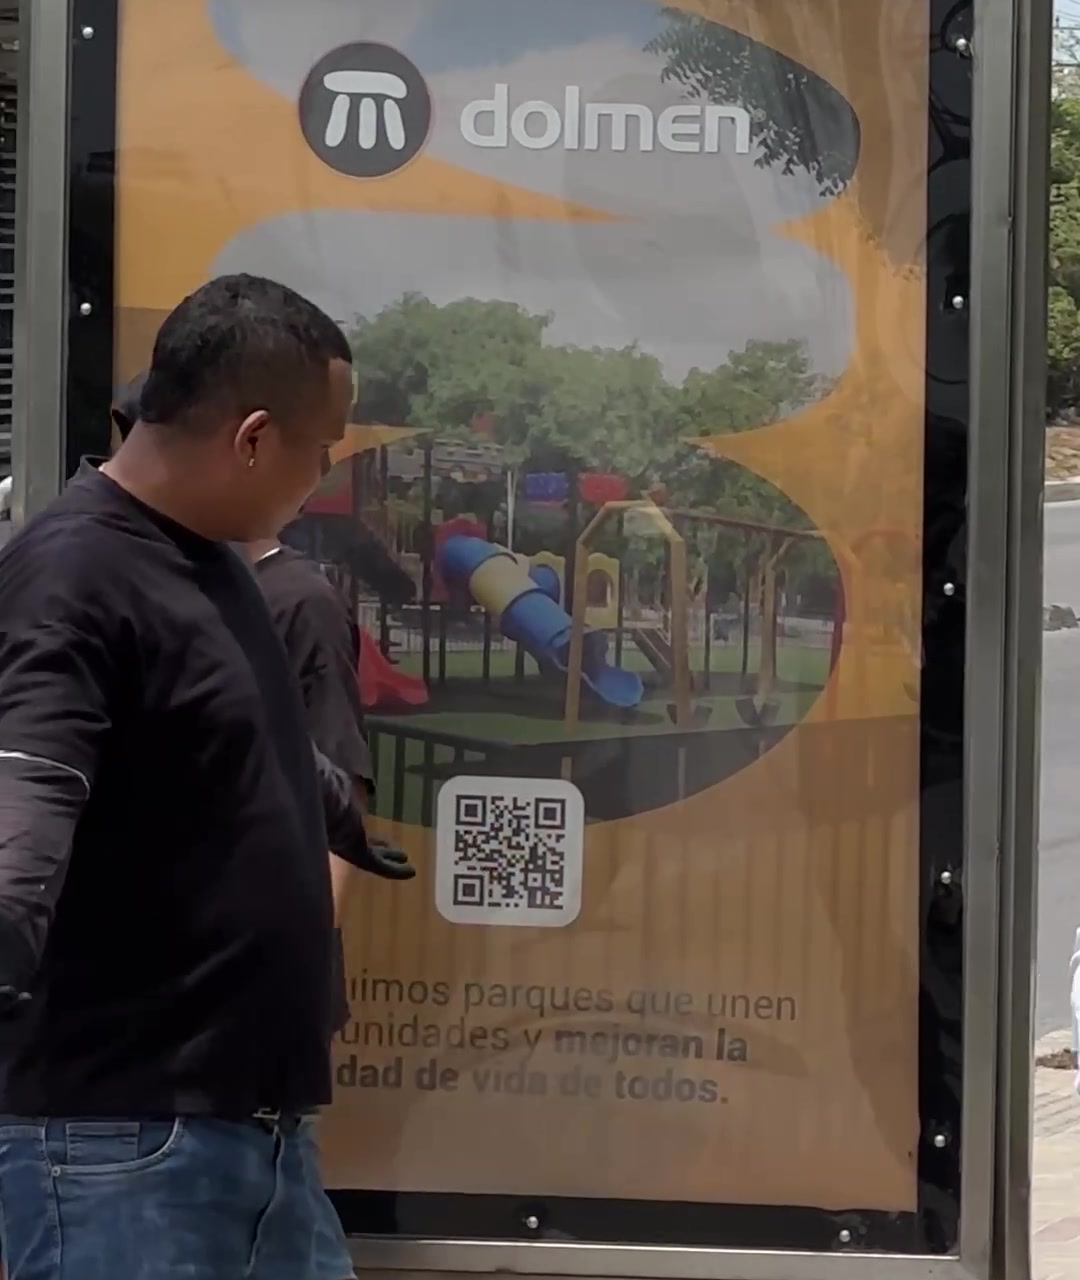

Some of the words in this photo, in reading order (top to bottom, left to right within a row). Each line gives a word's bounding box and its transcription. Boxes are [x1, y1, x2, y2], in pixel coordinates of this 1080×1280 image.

[460, 83, 750, 154] dolmen
[464, 982, 614, 1018] parques
[626, 990, 693, 1019] que
[707, 992, 797, 1021] unen
[524, 1027, 542, 1063] y
[554, 1023, 704, 1064] mejoran
[716, 1027, 748, 1062] la
[336, 1053, 403, 1088] dad
[415, 1058, 460, 1091] de
[472, 1060, 548, 1095] vida
[558, 1066, 602, 1098] de
[614, 1068, 728, 1104] todos.
